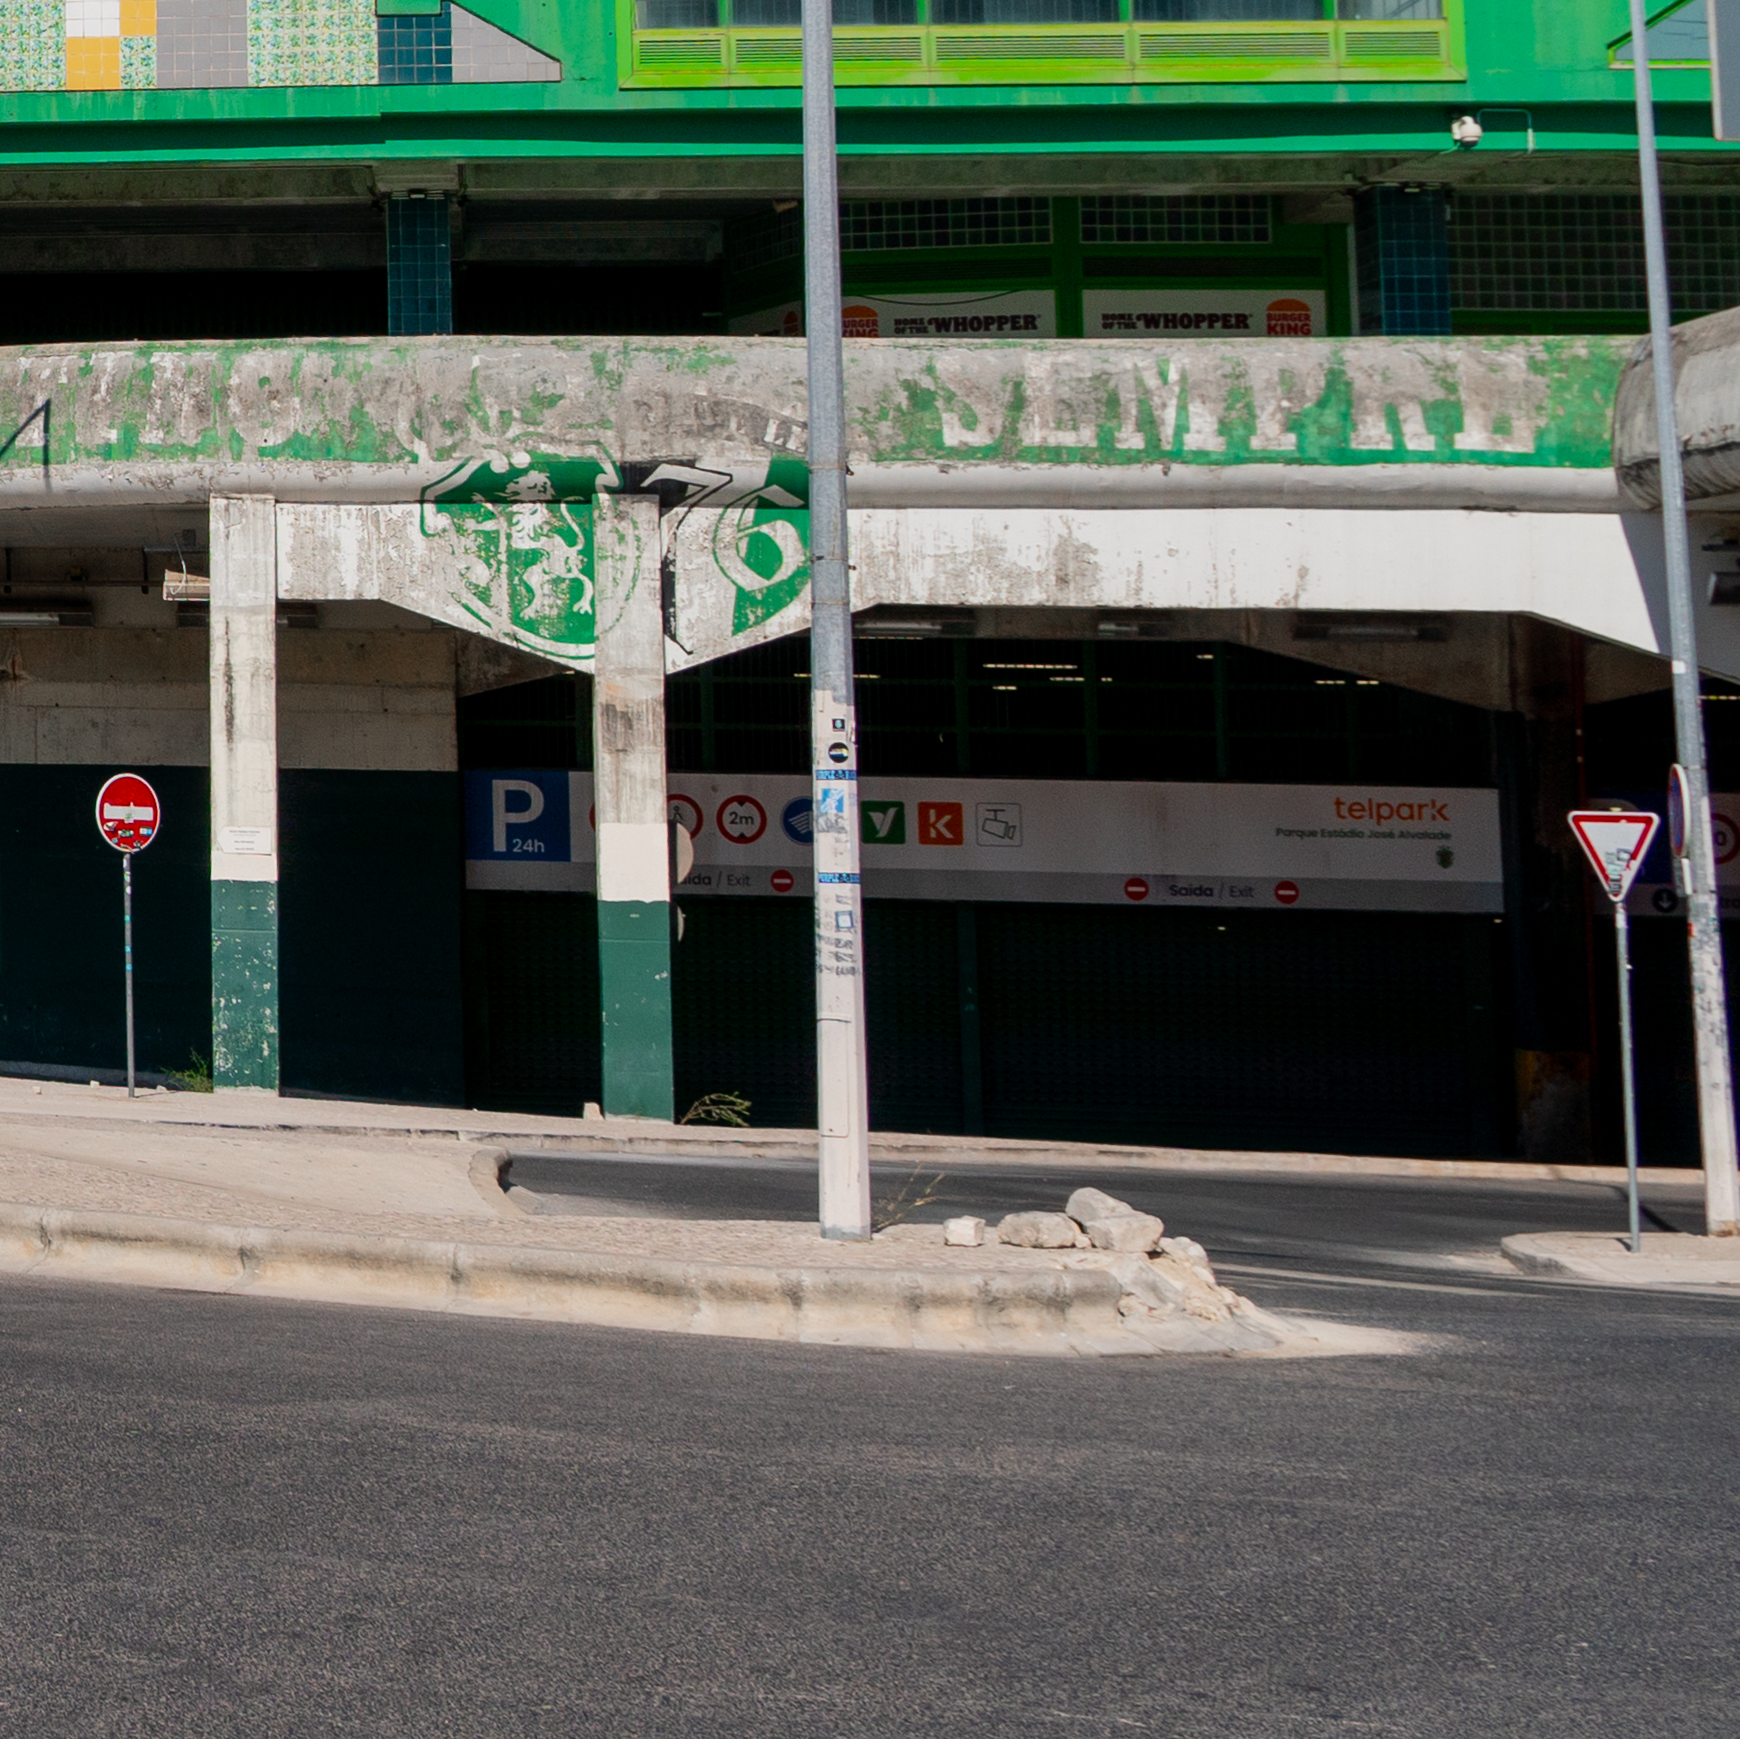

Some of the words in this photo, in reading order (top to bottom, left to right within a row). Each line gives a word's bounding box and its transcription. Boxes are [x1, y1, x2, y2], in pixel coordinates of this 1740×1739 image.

[842, 318, 879, 328] URGER
[894, 317, 925, 326] HOME
[927, 314, 1039, 333] WHOPPER
[1101, 313, 1134, 321] HOME
[1135, 313, 1250, 330] WHOPPER
[1266, 313, 1312, 322] BURGER
[894, 326, 907, 334] OF
[907, 325, 929, 334] THE
[1102, 321, 1116, 330] OF
[1117, 321, 1138, 330] THE
[1266, 322, 1312, 336] KING
[491, 779, 545, 852] P
[1334, 797, 1449, 826] telpark
[728, 811, 755, 827] 2m
[1275, 828, 1318, 840] Parque
[1320, 827, 1365, 838] Estádio
[1367, 828, 1395, 839] José
[1398, 830, 1452, 840] Alvalade
[512, 838, 545, 853] 24h
[727, 873, 751, 886] Exit
[1229, 885, 1254, 898] Exit
